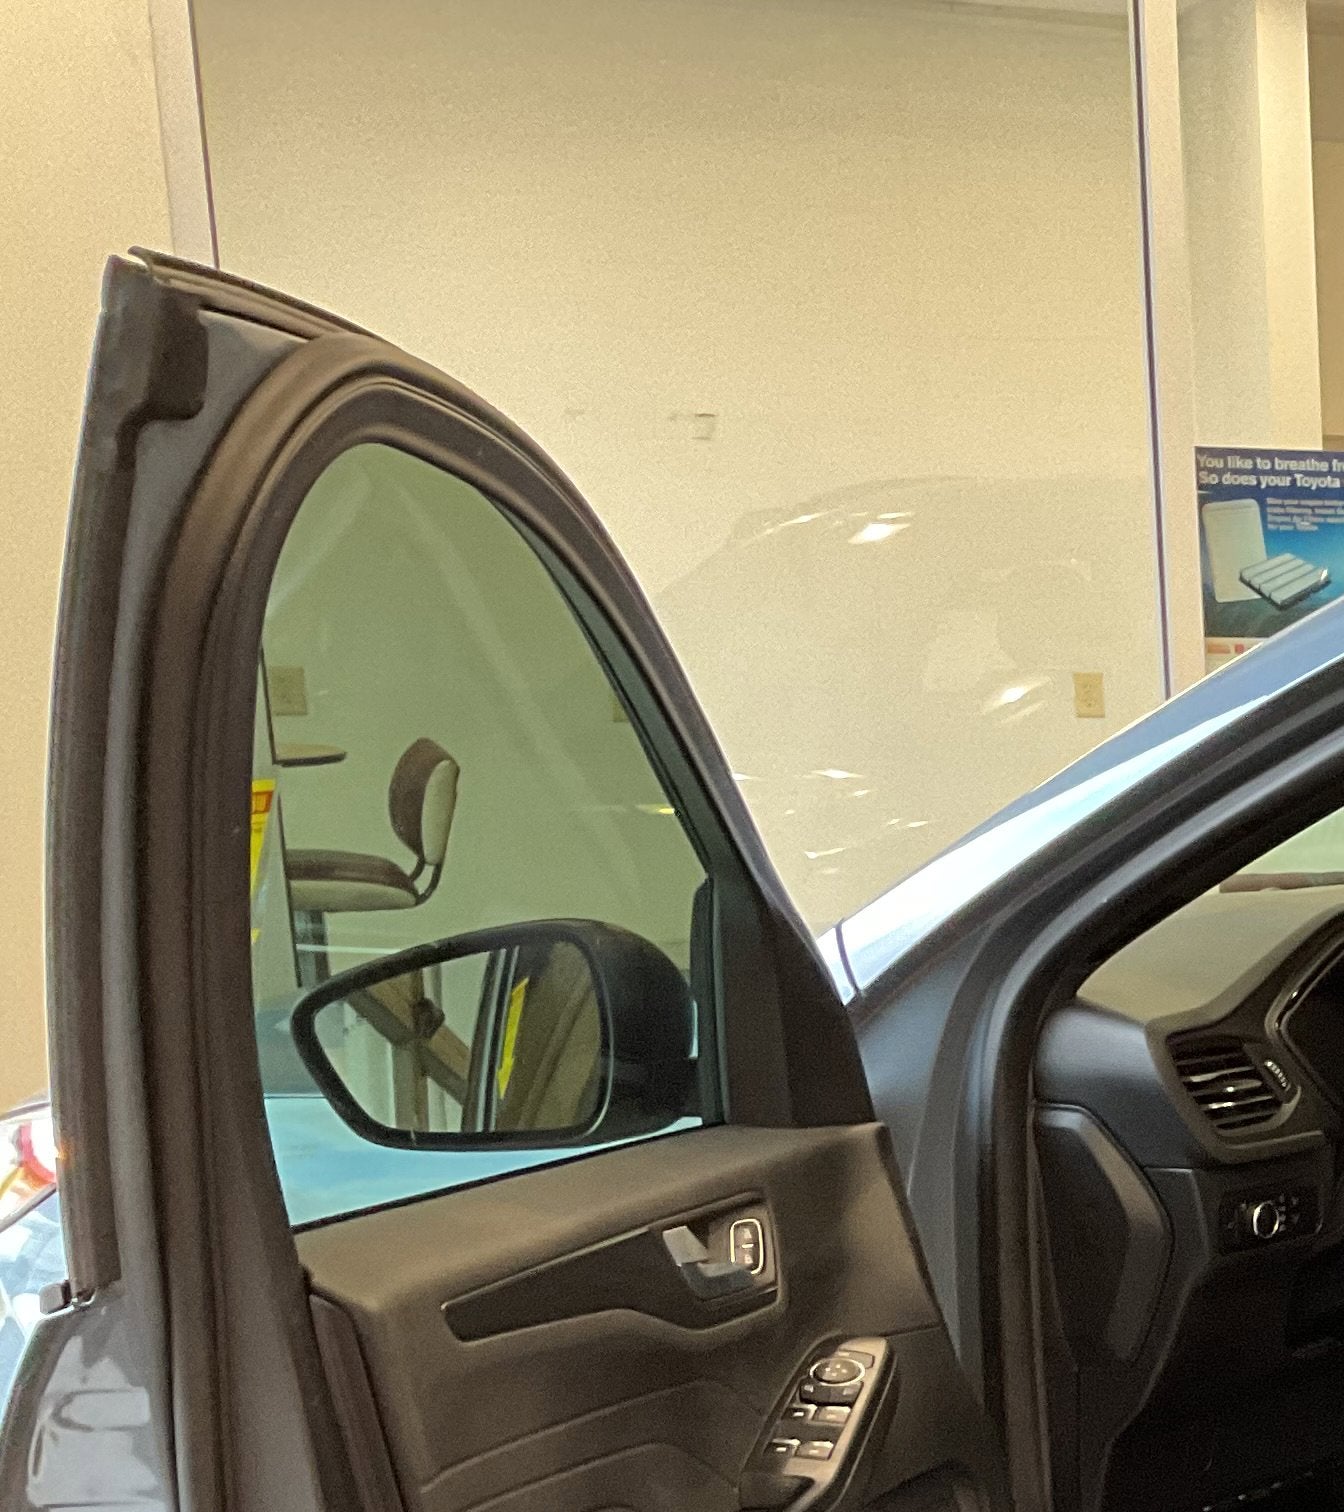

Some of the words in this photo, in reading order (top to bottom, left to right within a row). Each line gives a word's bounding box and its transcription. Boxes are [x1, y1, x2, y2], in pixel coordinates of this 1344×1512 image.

[1198, 456, 1224, 469] You
[1227, 456, 1253, 470] like
[1256, 457, 1271, 470] to
[1274, 457, 1329, 472] breathe
[1199, 472, 1218, 485] So
[1222, 472, 1256, 486] does
[1260, 476, 1291, 489] your
[1294, 474, 1340, 490] Toyota
